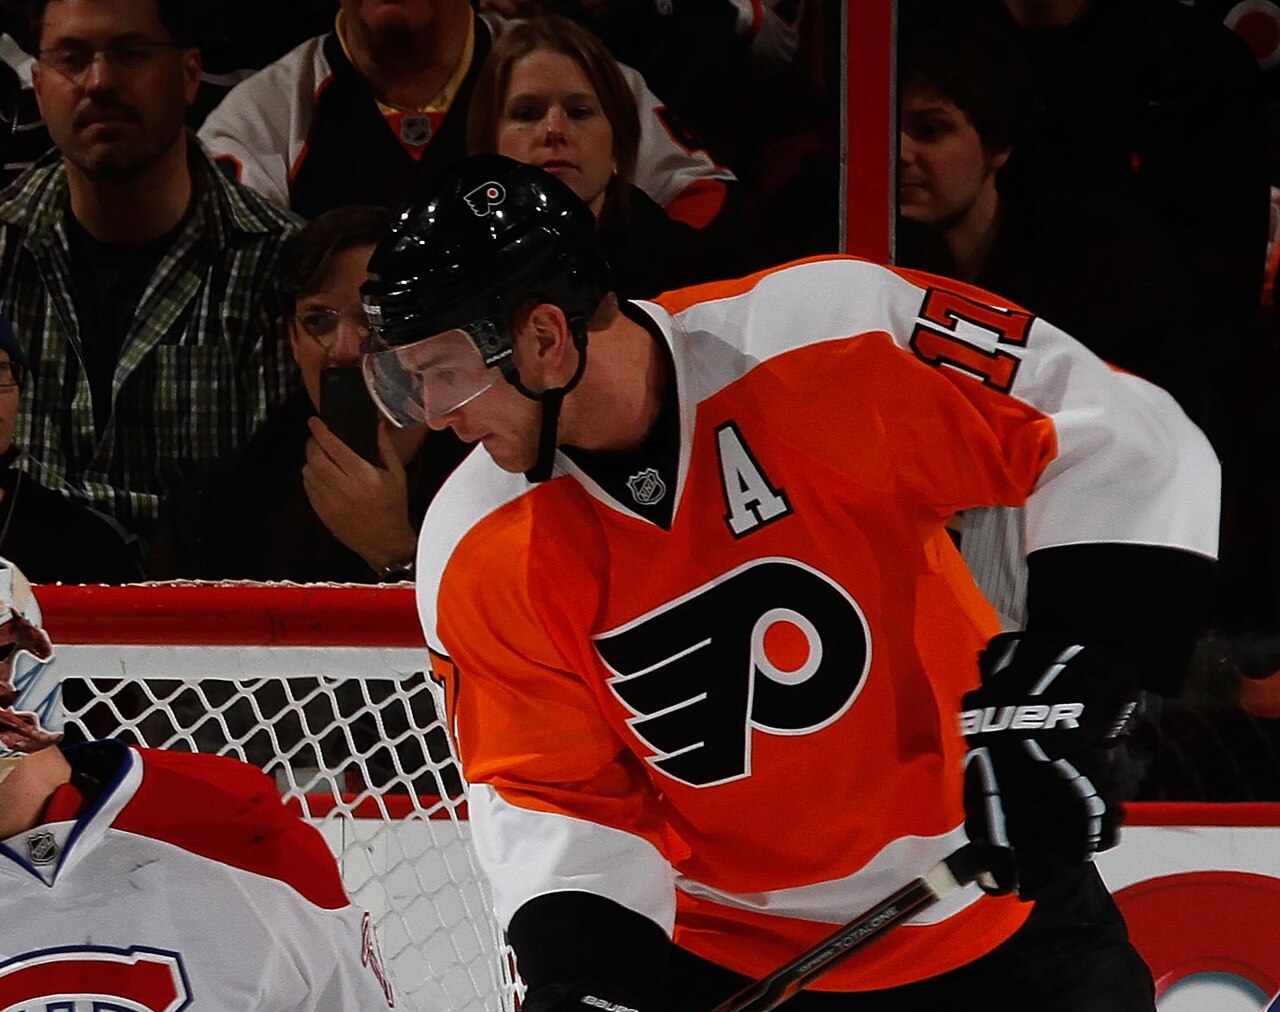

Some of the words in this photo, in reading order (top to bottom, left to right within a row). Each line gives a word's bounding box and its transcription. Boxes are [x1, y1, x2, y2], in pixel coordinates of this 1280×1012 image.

[909, 286, 1037, 395] 17
[714, 418, 795, 540] A
[958, 702, 1086, 736] AUER
